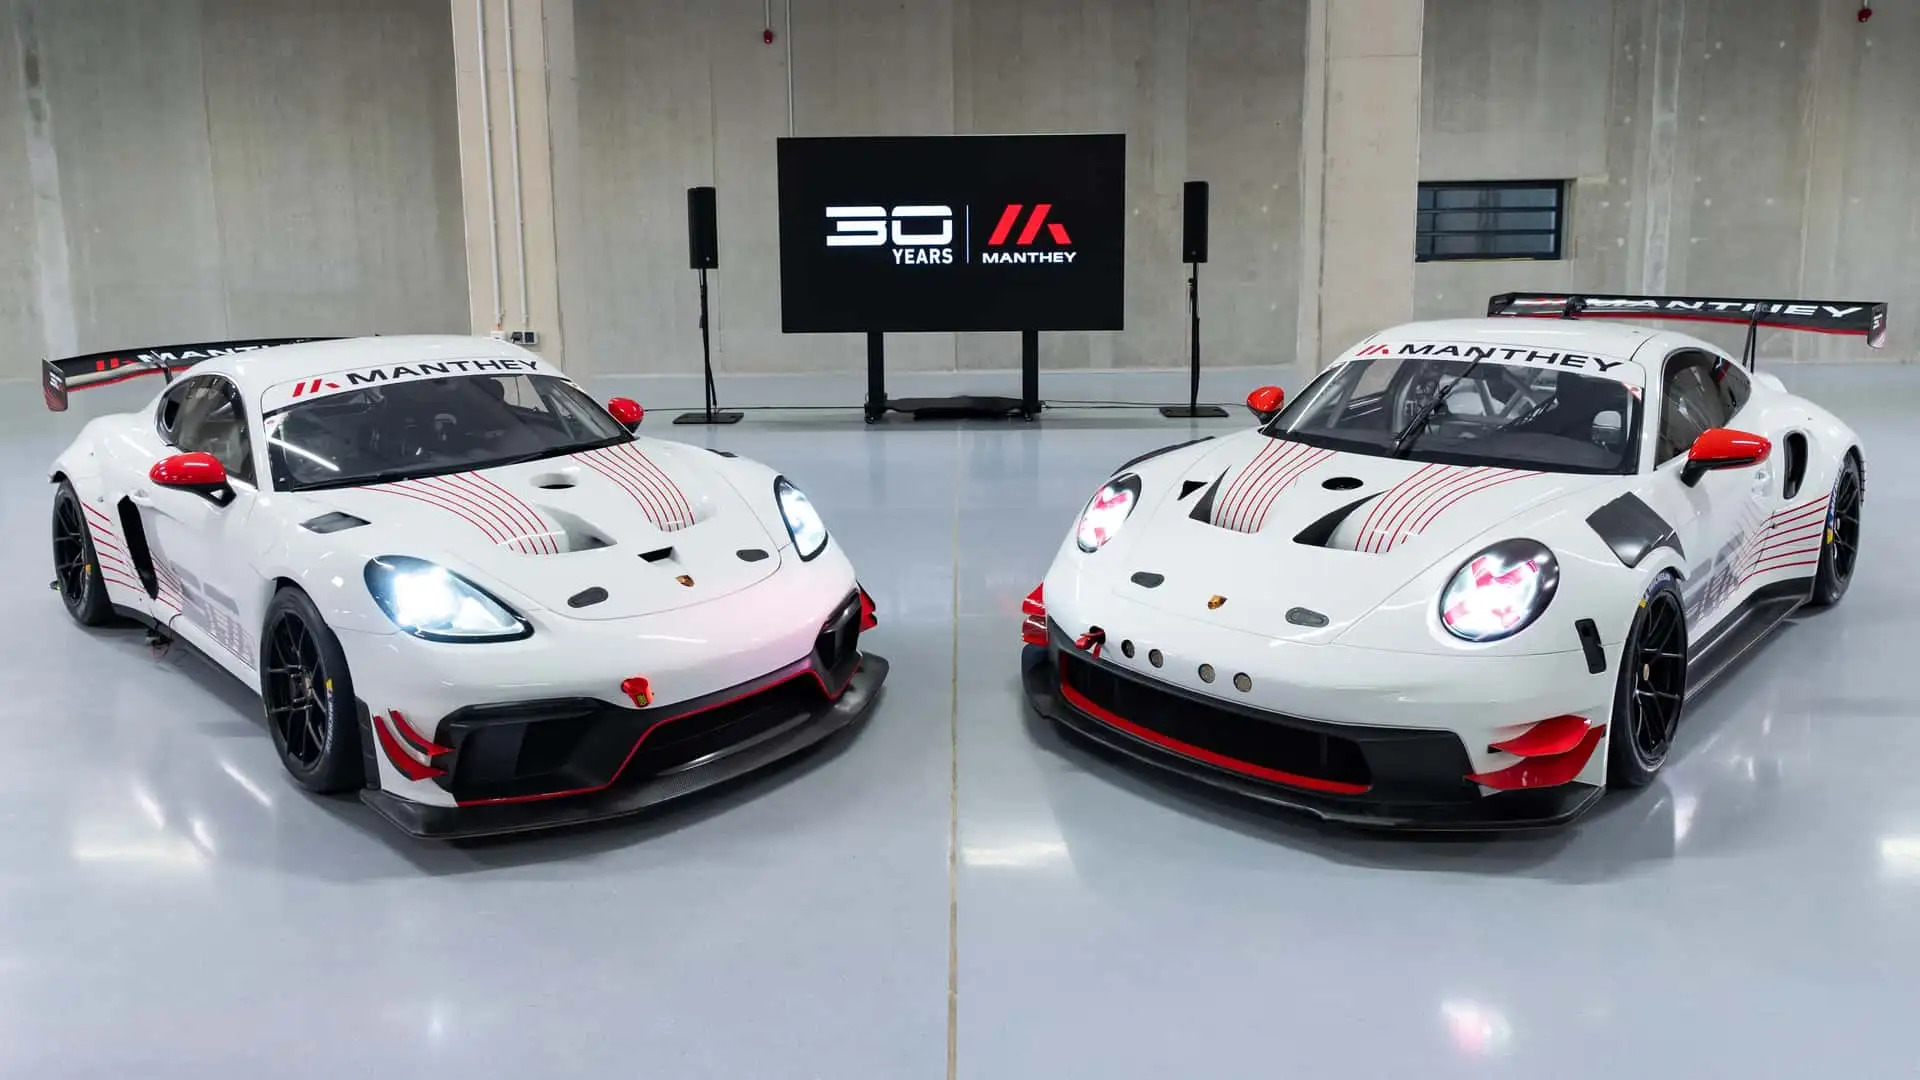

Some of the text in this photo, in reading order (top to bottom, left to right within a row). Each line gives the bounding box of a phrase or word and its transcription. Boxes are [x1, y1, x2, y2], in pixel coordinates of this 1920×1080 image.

[826, 206, 952, 246] 30
[892, 248, 953, 264] YEARS
[982, 251, 1077, 264] MANTHEY
[1398, 343, 1625, 372] MANTHEY
[345, 359, 538, 385] MANTHEY
